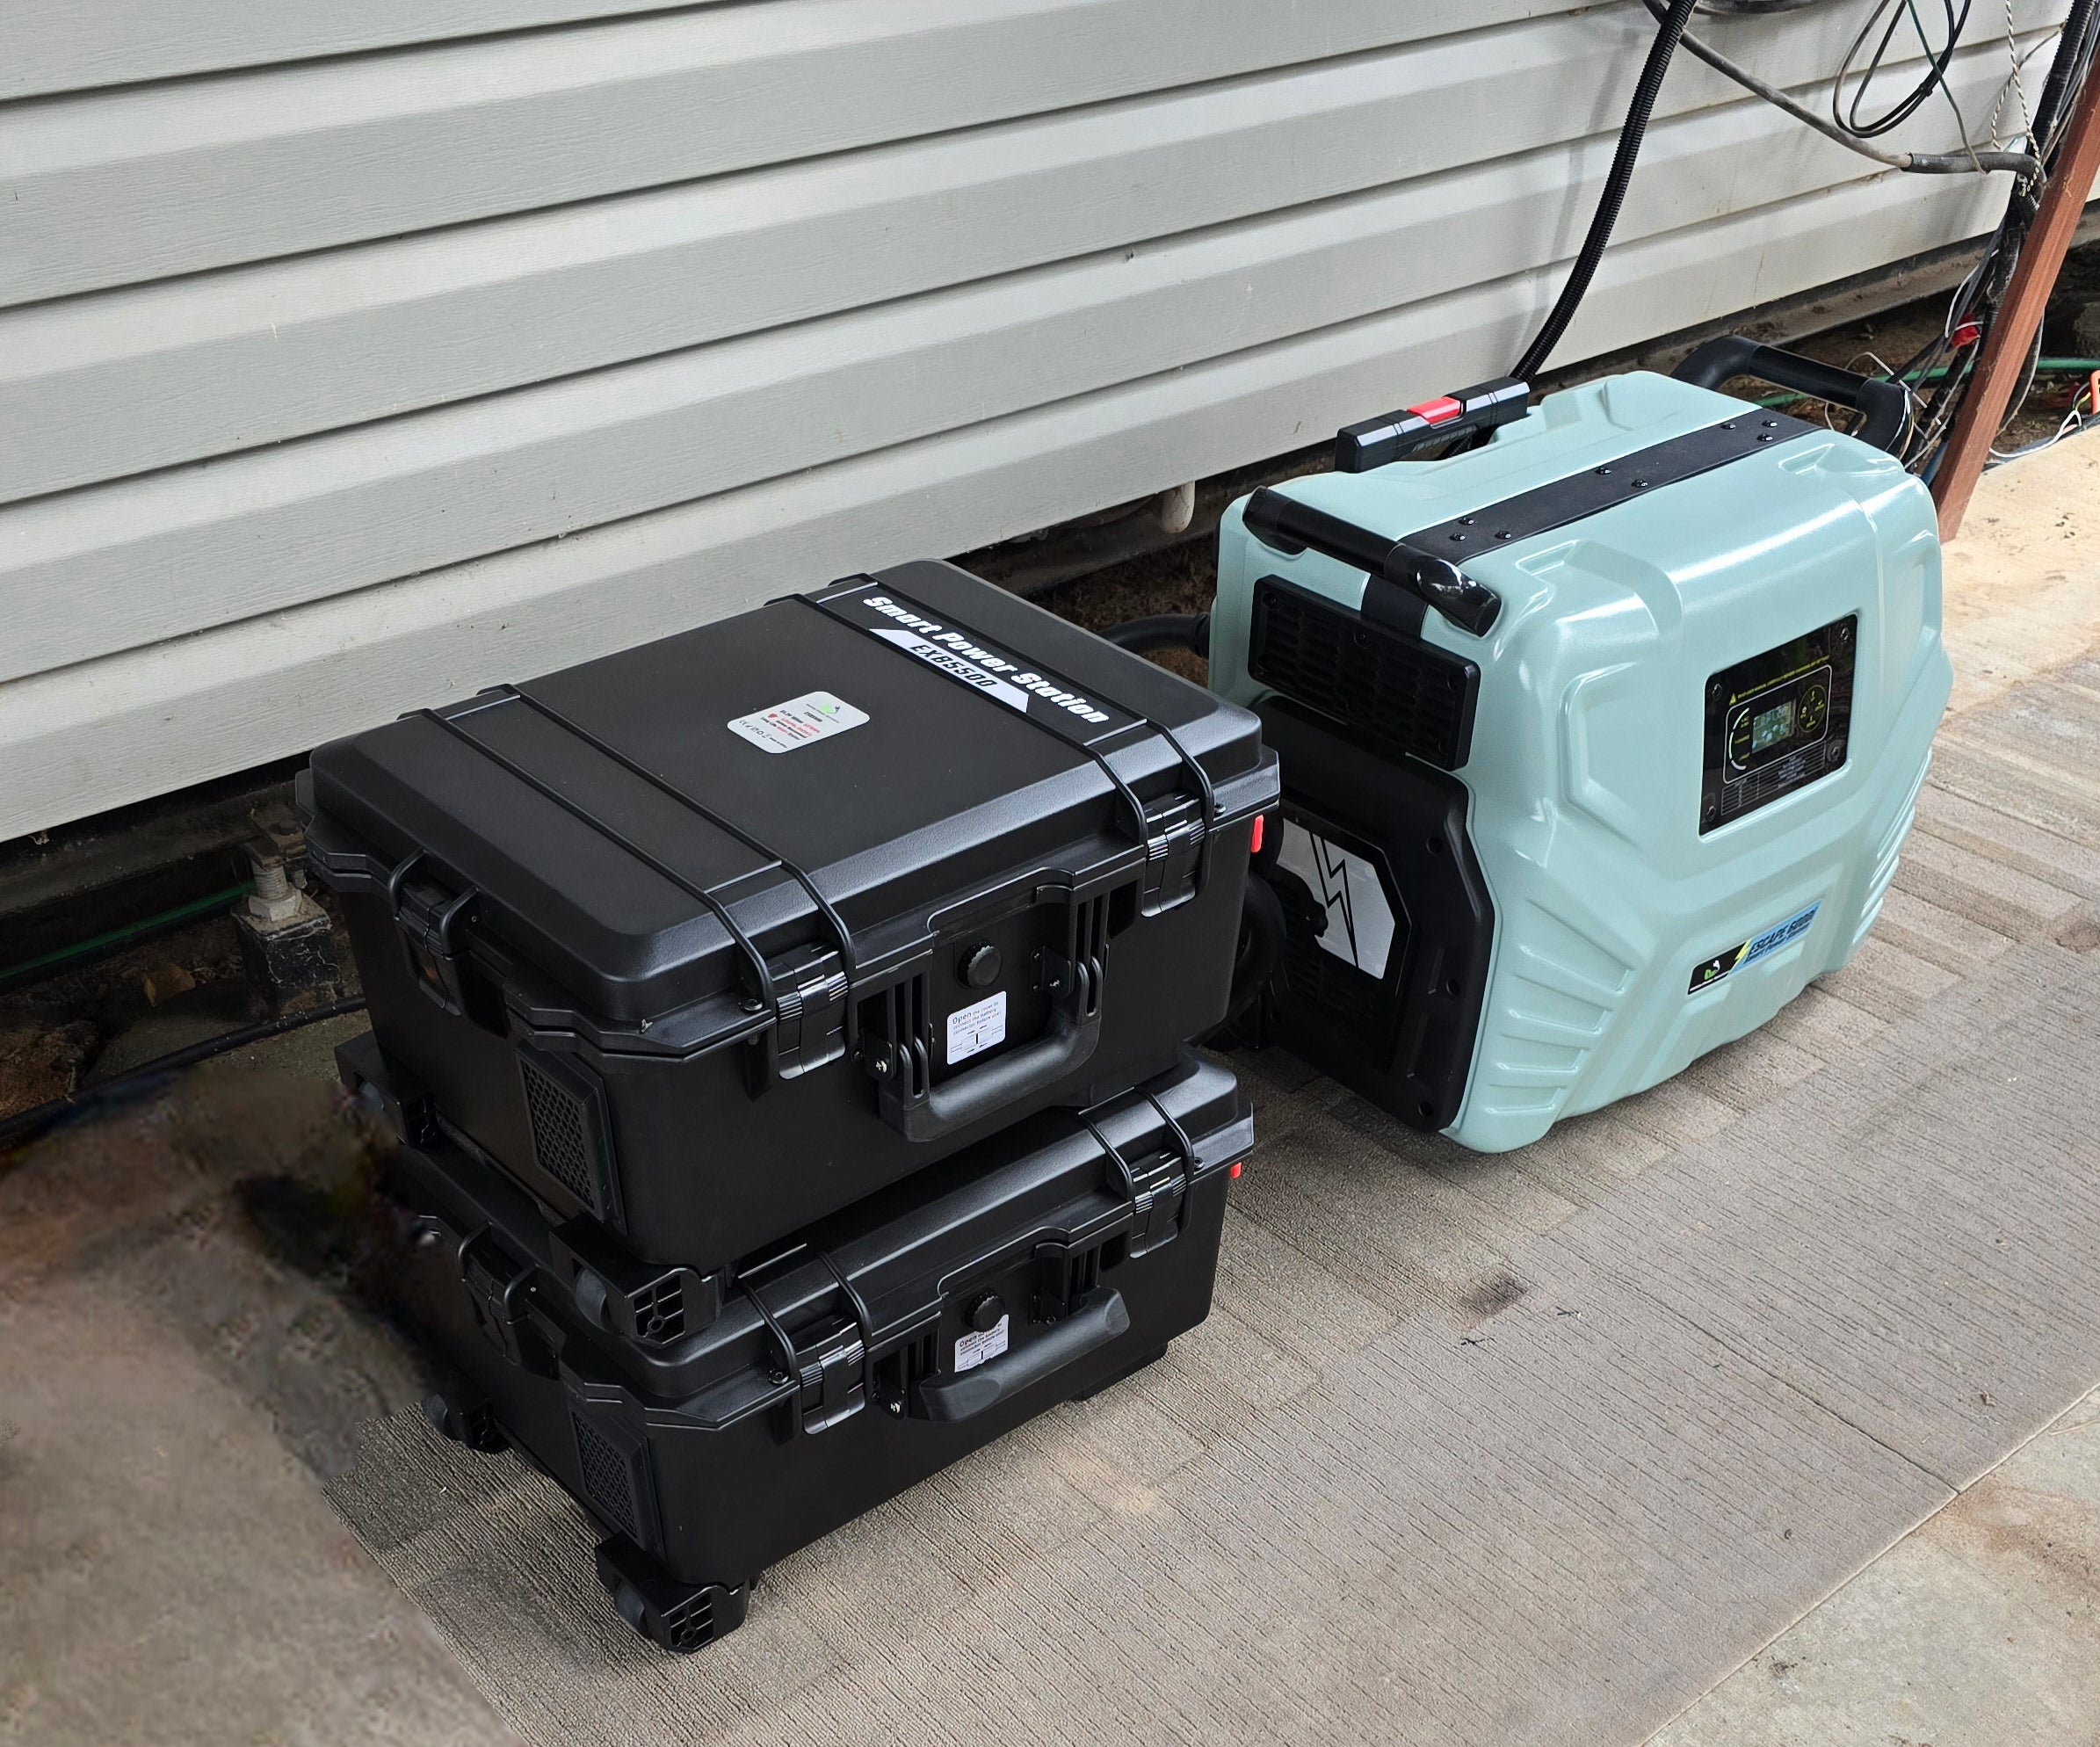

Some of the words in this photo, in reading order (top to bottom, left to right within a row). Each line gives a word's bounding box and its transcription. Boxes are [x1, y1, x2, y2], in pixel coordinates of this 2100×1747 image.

[863, 597, 943, 634] Smart
[931, 632, 1018, 673] Power
[1010, 671, 1110, 723] Station
[911, 644, 998, 688] EXB5500
[1748, 924, 1789, 956] ESCAPE
[952, 1012, 972, 1025] Open
[959, 1335, 977, 1348] Open
